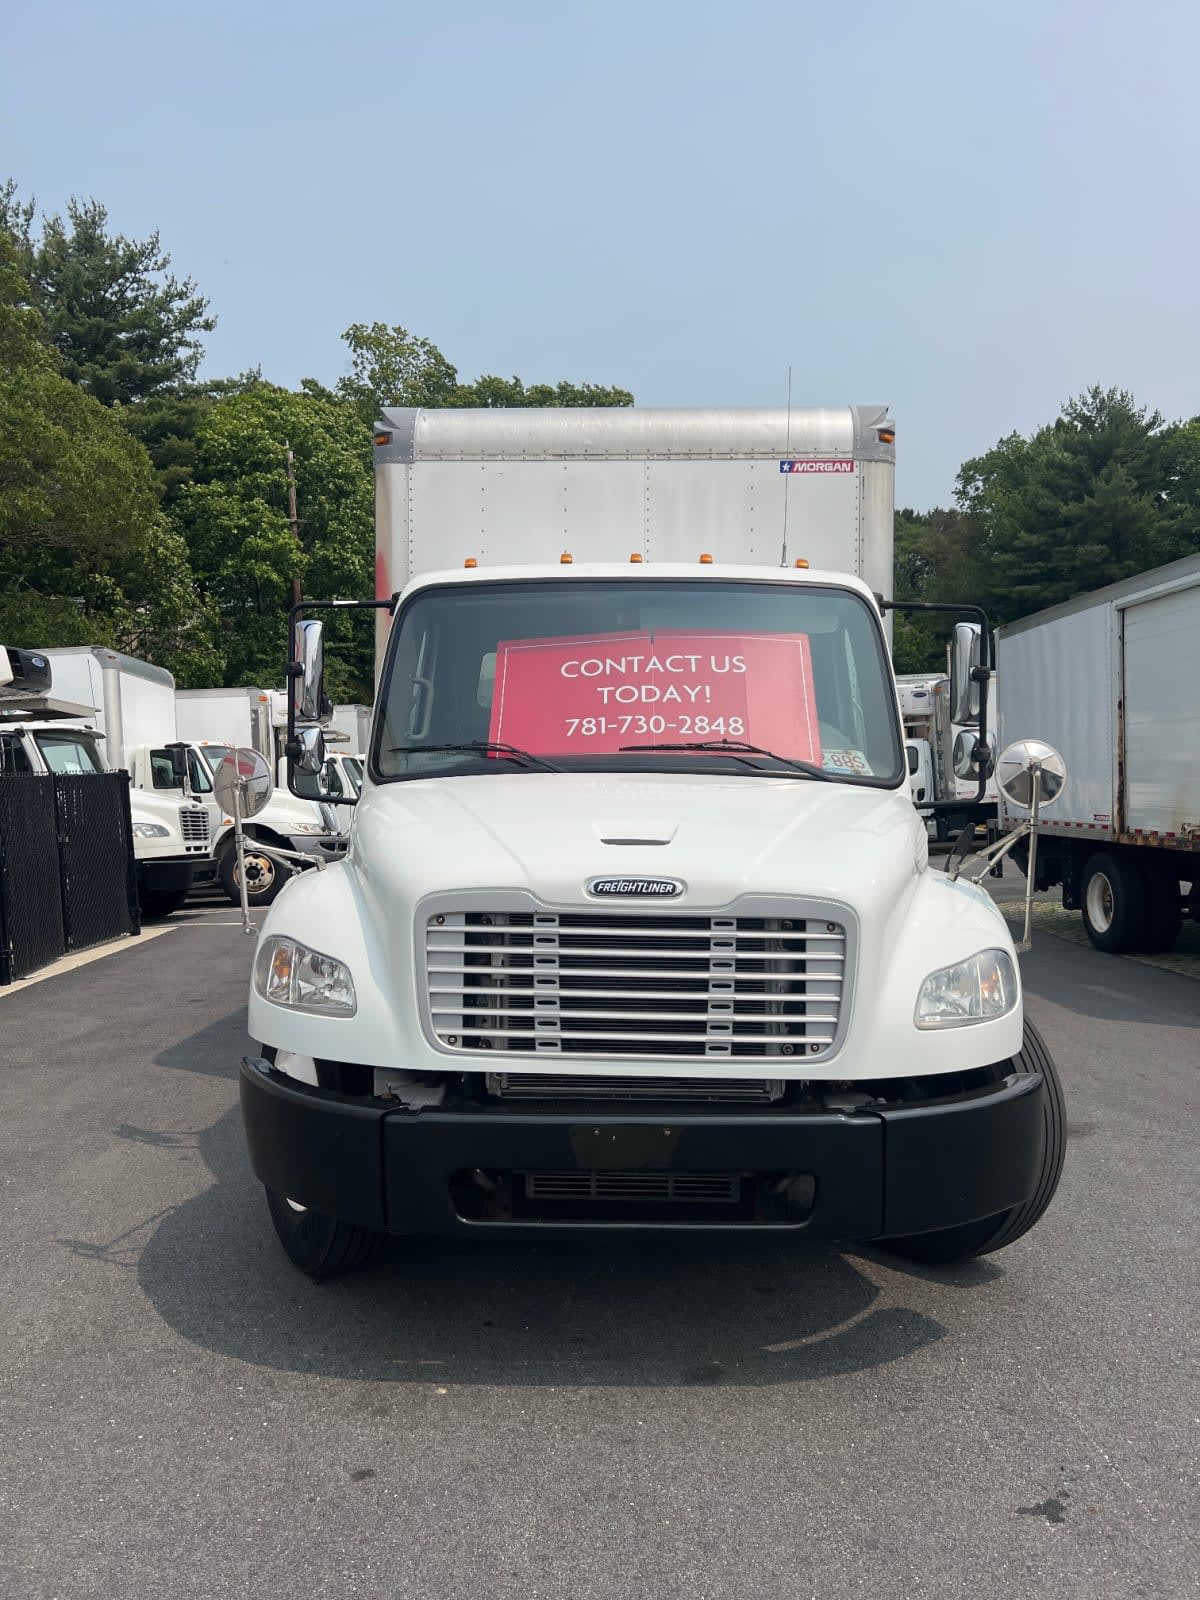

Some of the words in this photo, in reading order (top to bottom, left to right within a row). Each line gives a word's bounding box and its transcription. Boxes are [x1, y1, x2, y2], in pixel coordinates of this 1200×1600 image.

[793, 462, 852, 472] MORGAN
[560, 655, 702, 678] CONTACT
[710, 655, 747, 673] US
[597, 685, 711, 704] TODAY!
[565, 715, 745, 736] 781-730-2848
[597, 880, 673, 893] FREIGHTLINER
